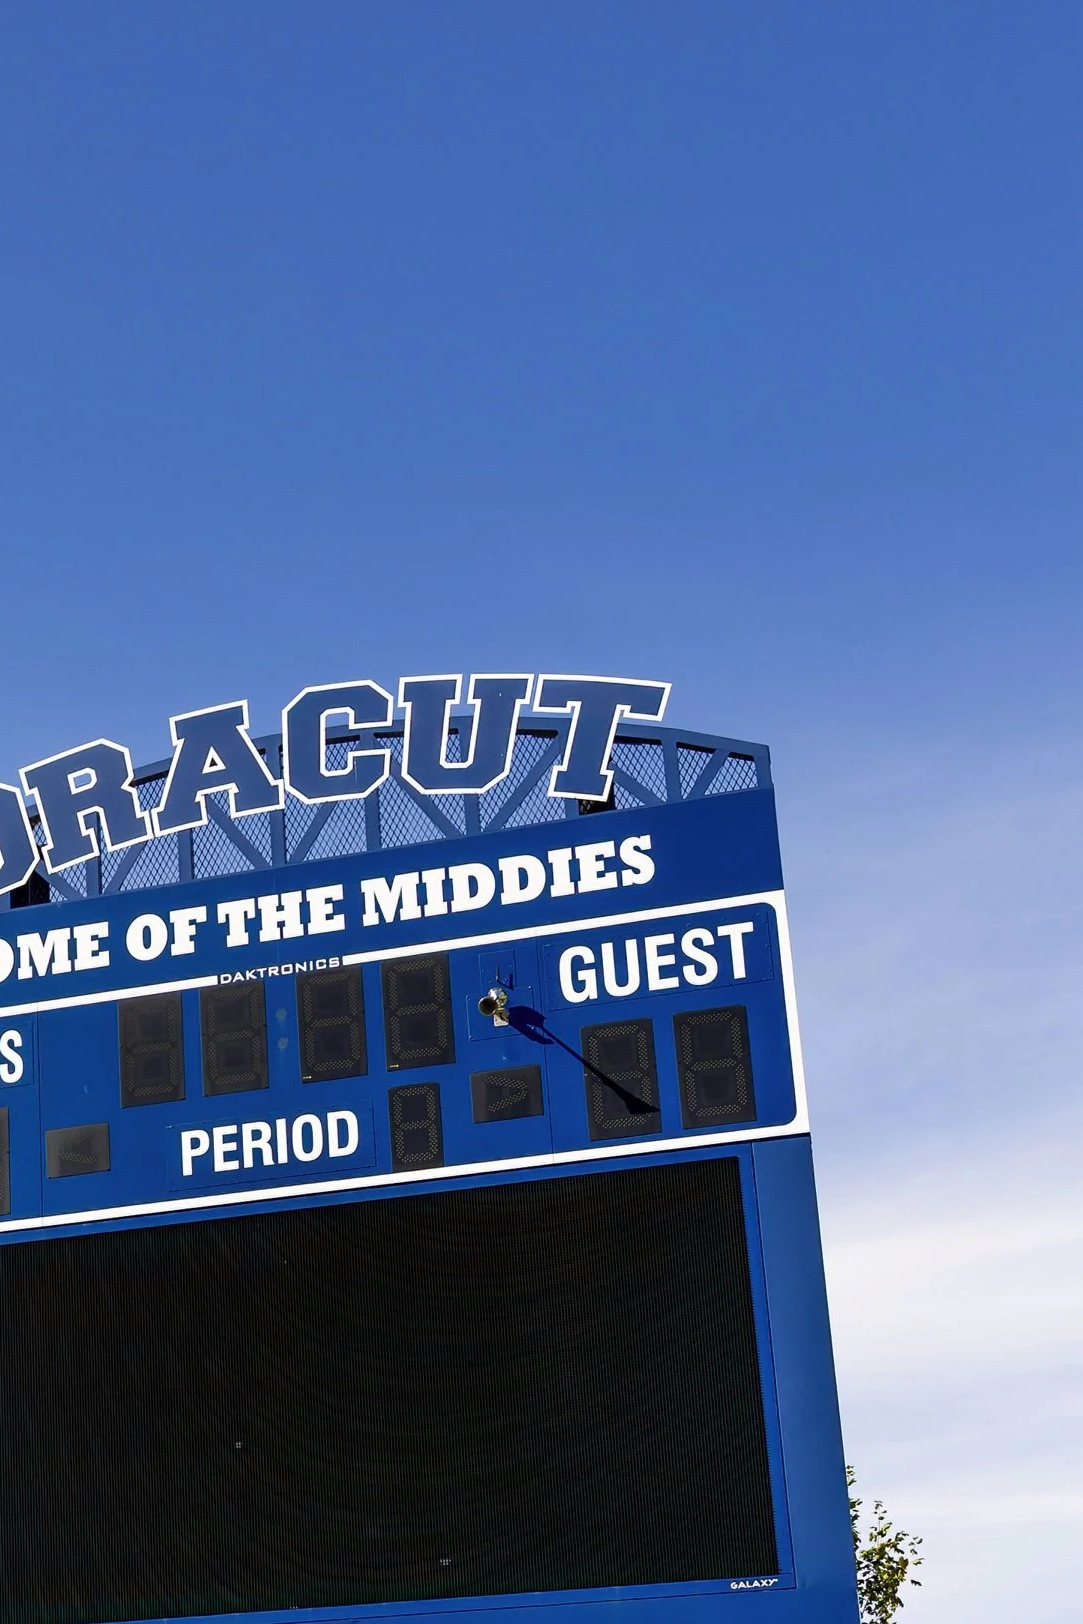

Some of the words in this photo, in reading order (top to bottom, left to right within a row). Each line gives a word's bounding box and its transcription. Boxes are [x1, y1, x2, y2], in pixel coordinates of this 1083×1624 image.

[125, 906, 207, 961] OF
[218, 884, 346, 948] THE
[361, 835, 655, 928] MIDDIES
[220, 956, 340, 984] DAKTRONICS
[559, 922, 754, 1003] GUEST
[180, 1110, 359, 1176] PERIOD
